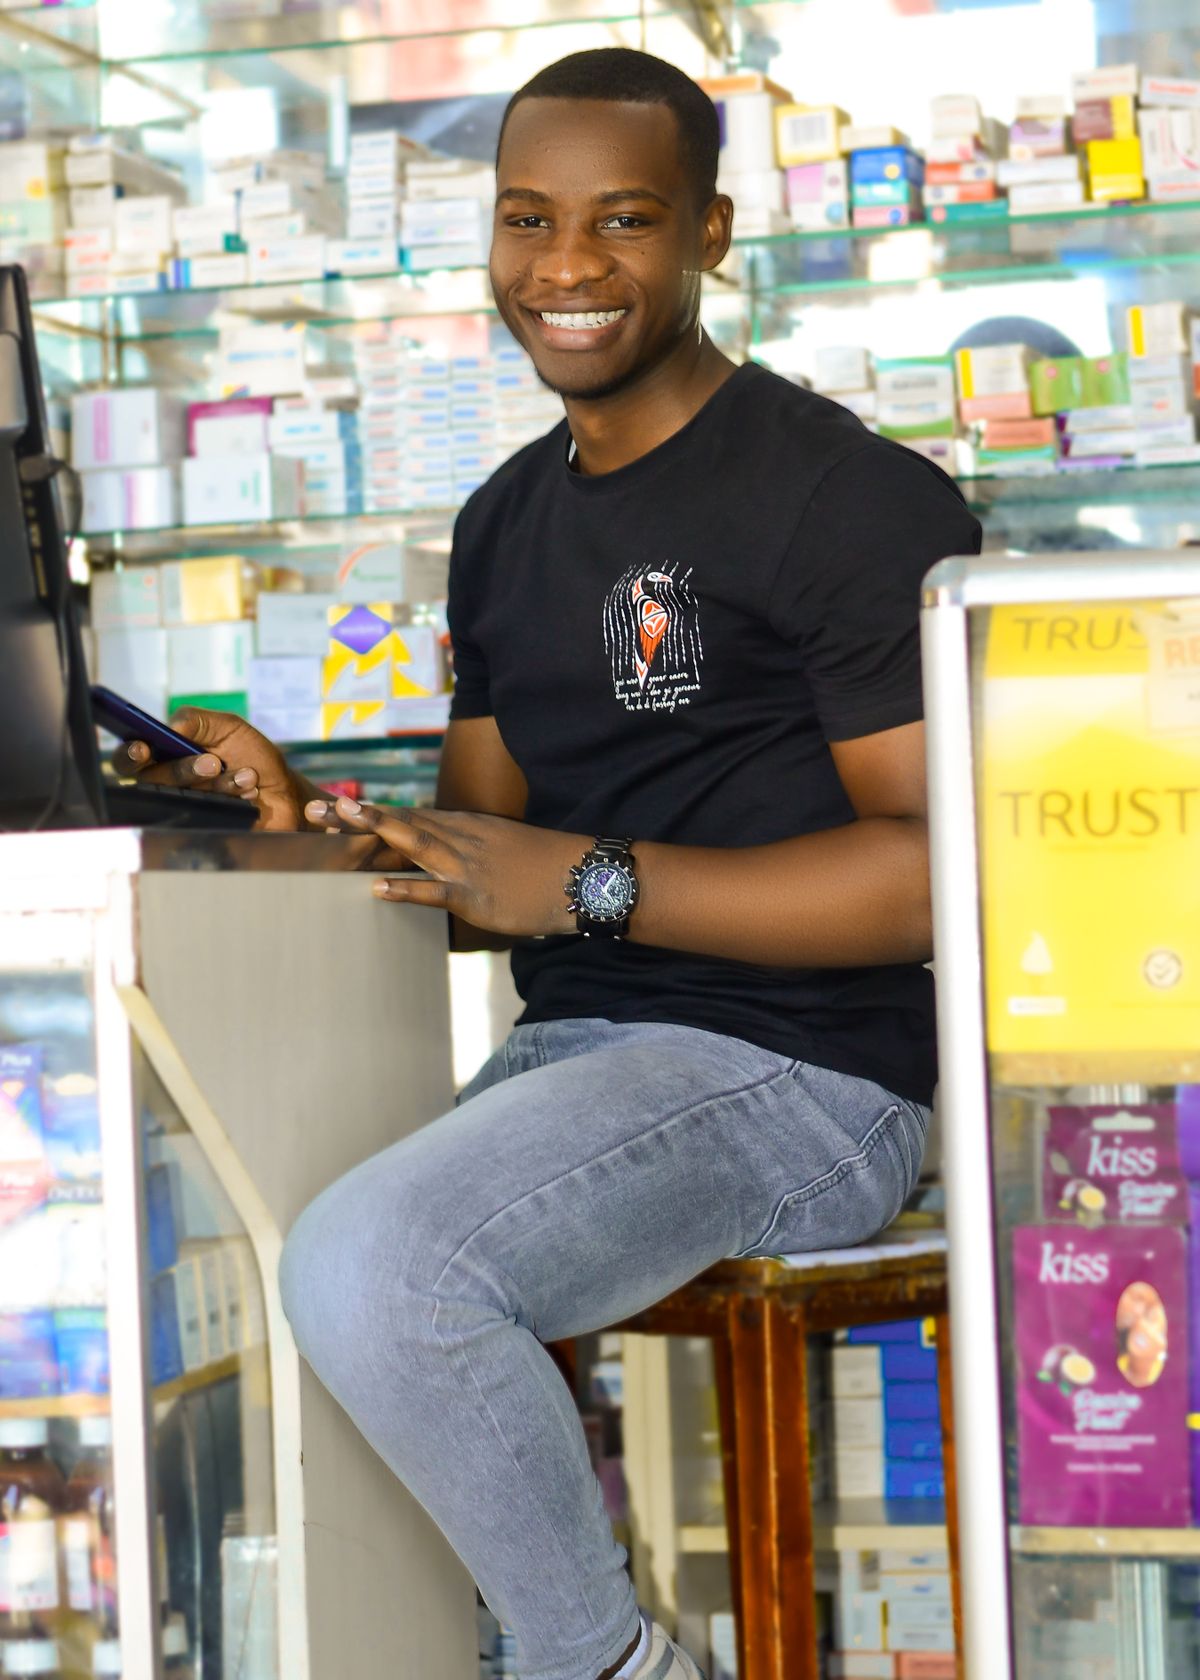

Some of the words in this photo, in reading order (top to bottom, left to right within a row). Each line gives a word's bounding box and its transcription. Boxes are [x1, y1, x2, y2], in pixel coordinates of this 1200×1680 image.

[1000, 787, 1199, 838] TRUST
[1087, 1135, 1157, 1177] kiss
[1039, 1242, 1109, 1284] kiss
